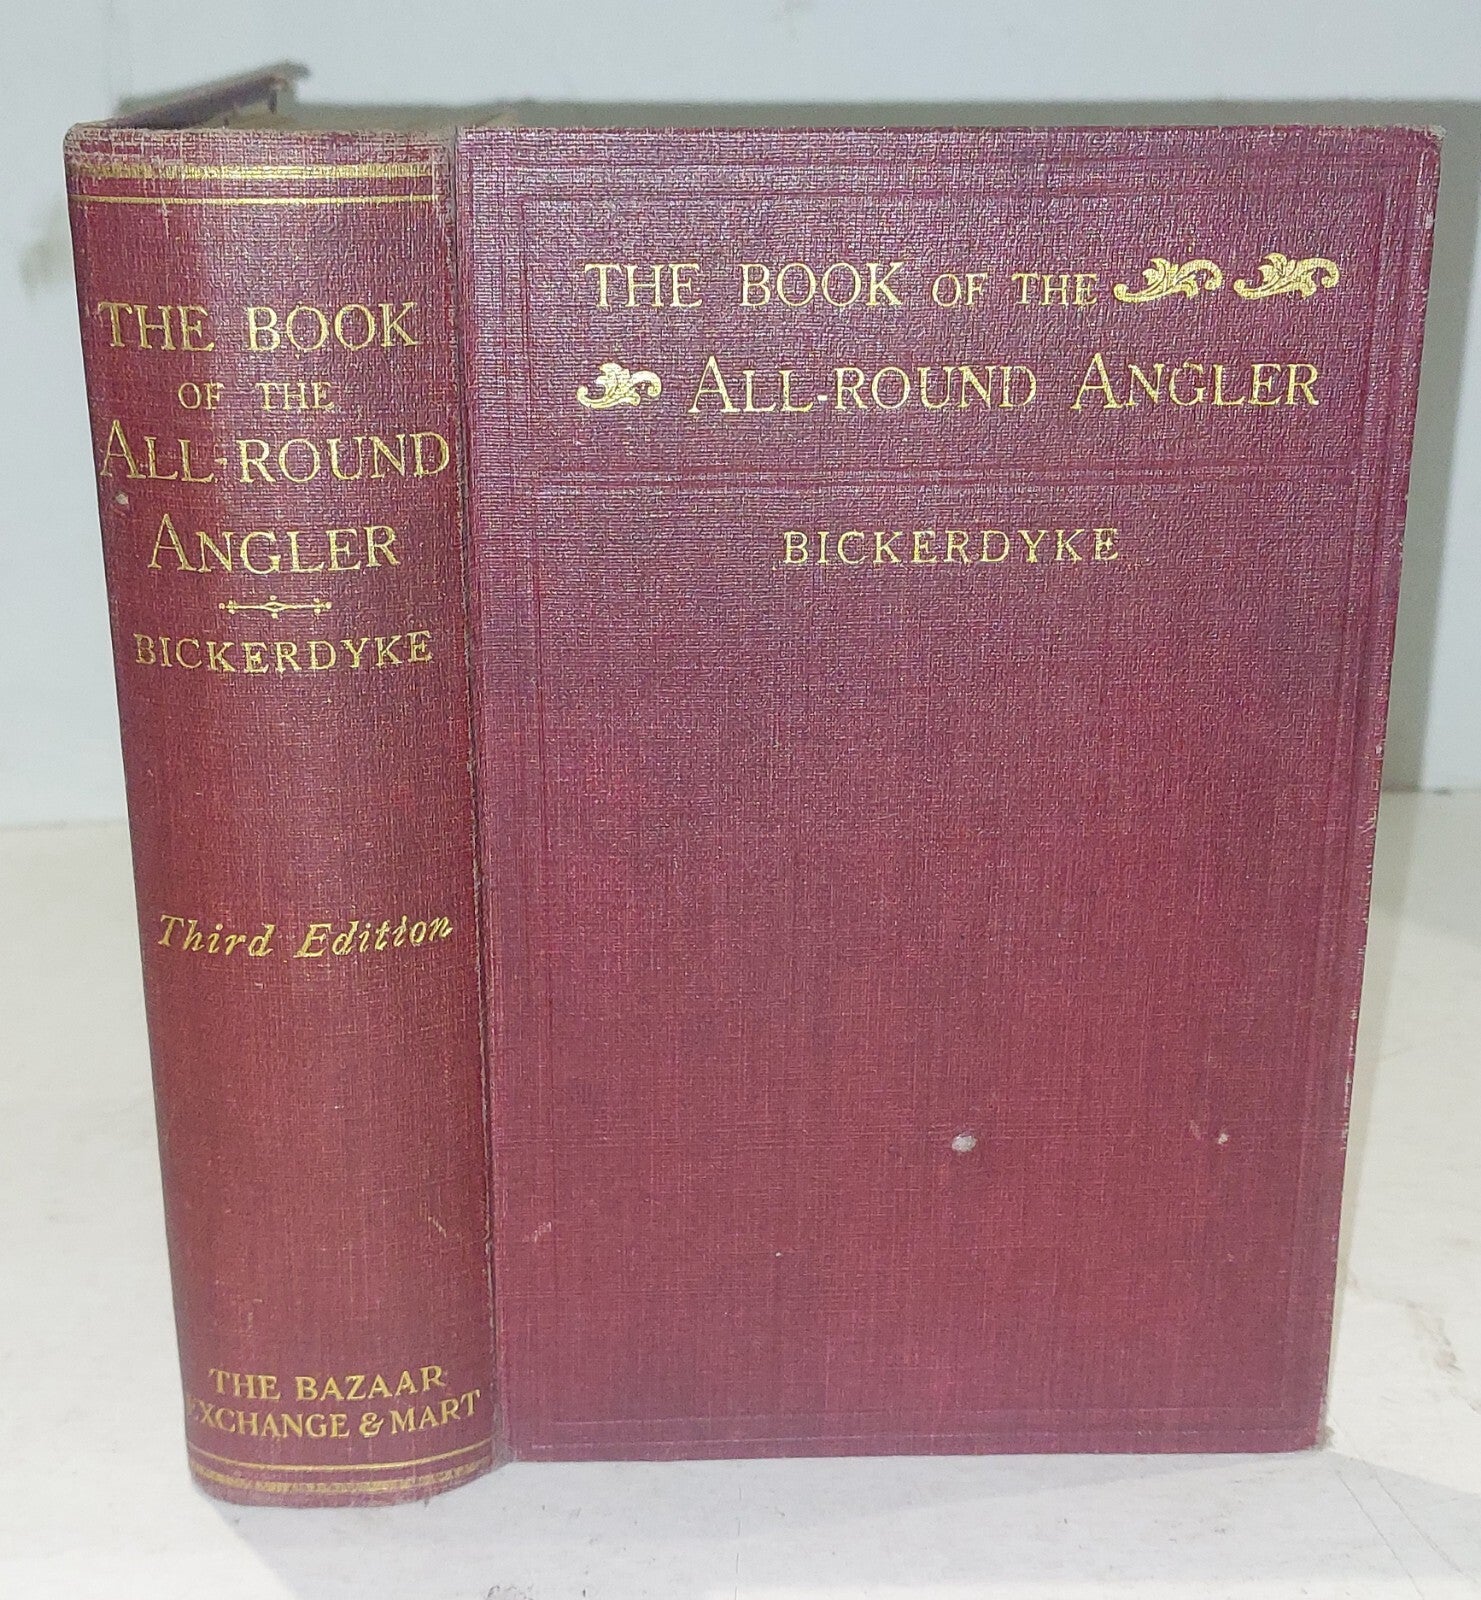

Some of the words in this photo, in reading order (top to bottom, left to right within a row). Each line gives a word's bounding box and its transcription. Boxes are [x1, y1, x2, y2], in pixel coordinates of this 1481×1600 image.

[584, 262, 703, 308] THE
[739, 260, 904, 308] BOOK
[931, 273, 989, 307] OF
[1011, 271, 1099, 307] THE
[97, 301, 215, 351] THE
[247, 301, 418, 352] BOOK
[178, 381, 223, 411] OF
[257, 380, 335, 411] THE
[688, 355, 1037, 415] ALL-ROUND
[1071, 352, 1321, 410] ANGLER
[148, 513, 400, 575] ANGLER
[782, 527, 1120, 566] BICKERDYKE
[134, 629, 434, 674] BICKERDYKE
[157, 914, 276, 957] Third
[293, 913, 453, 959] Edition
[209, 1368, 281, 1401] THE
[296, 1364, 446, 1401] BAZAAR
[359, 1412, 384, 1438] &
[390, 1388, 482, 1435] MART
